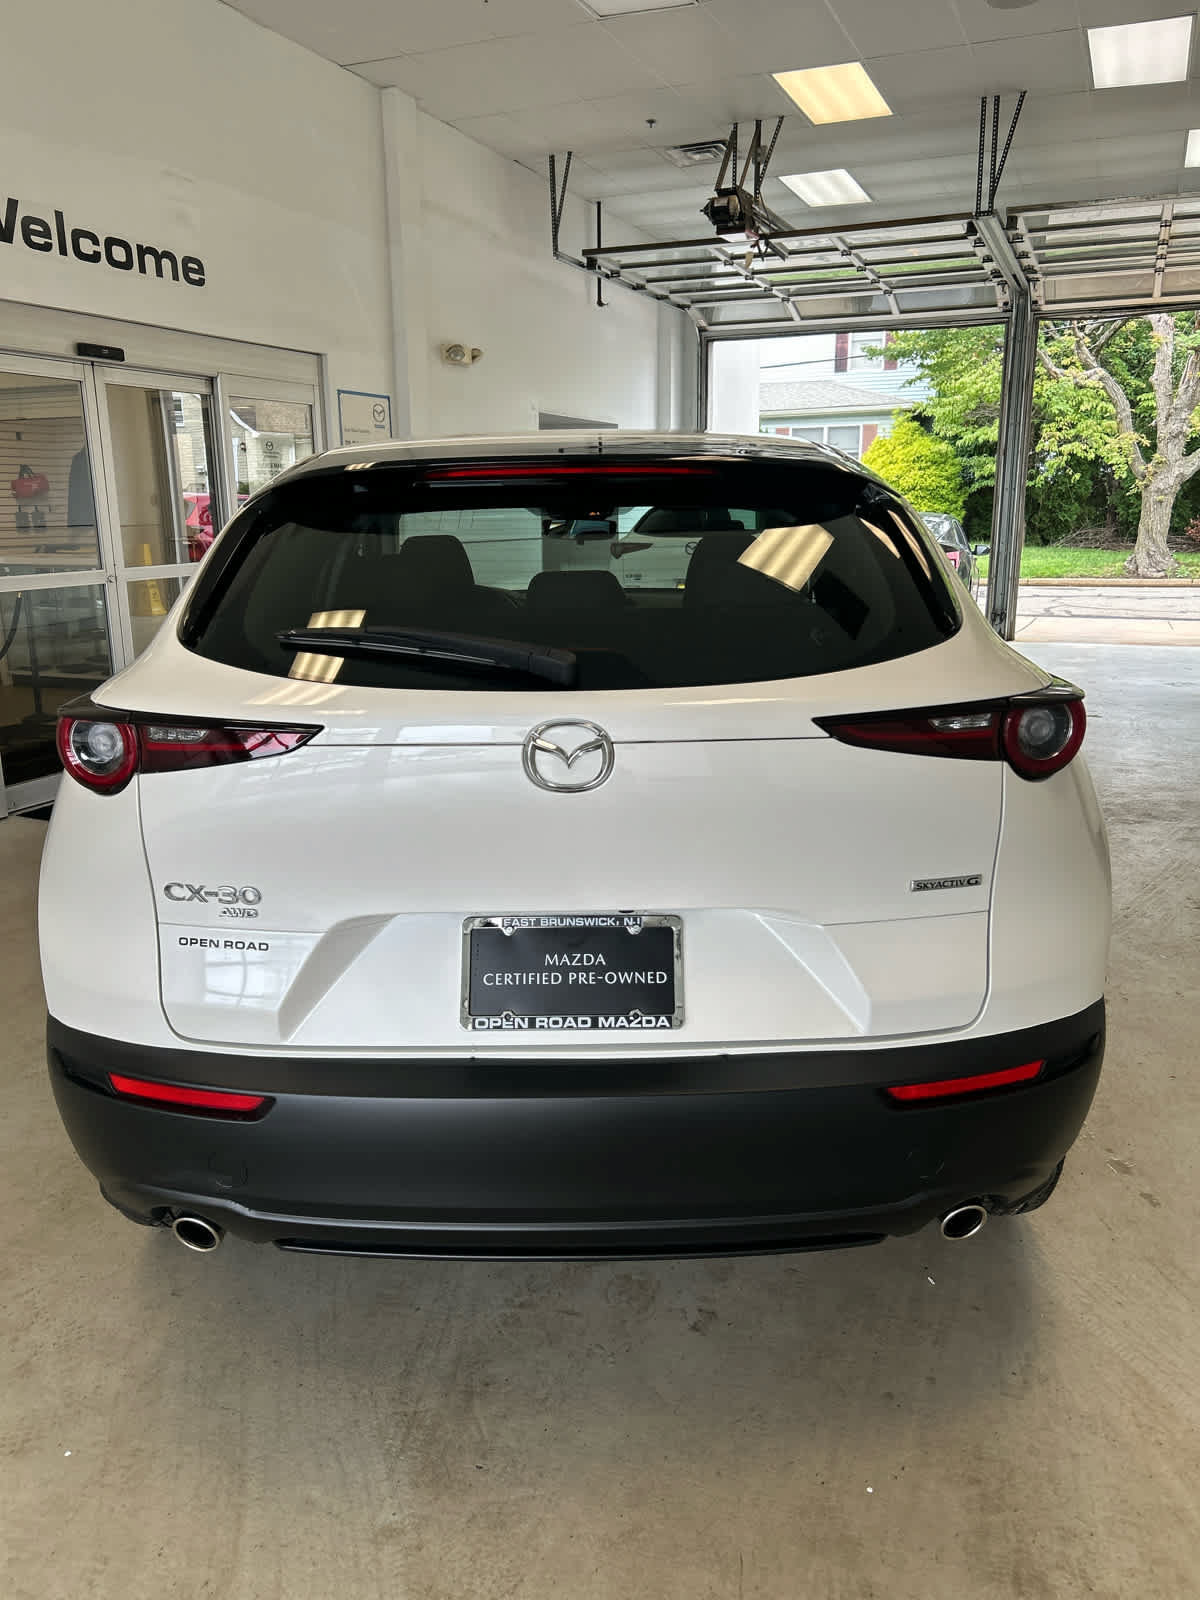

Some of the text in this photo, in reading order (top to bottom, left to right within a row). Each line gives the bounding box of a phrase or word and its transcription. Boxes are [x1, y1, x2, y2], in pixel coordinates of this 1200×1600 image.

[163, 882, 262, 905] CX-30
[218, 907, 259, 918] AWD
[503, 917, 536, 927] EAST
[541, 917, 620, 927] BRUNSWICK,
[178, 936, 270, 951] OPEN ROAD
[544, 953, 607, 966] MAZDA
[482, 971, 668, 986] CERTIFIED PRE-OWNED
[474, 1016, 671, 1029] OPEN ROAD MAZDA
